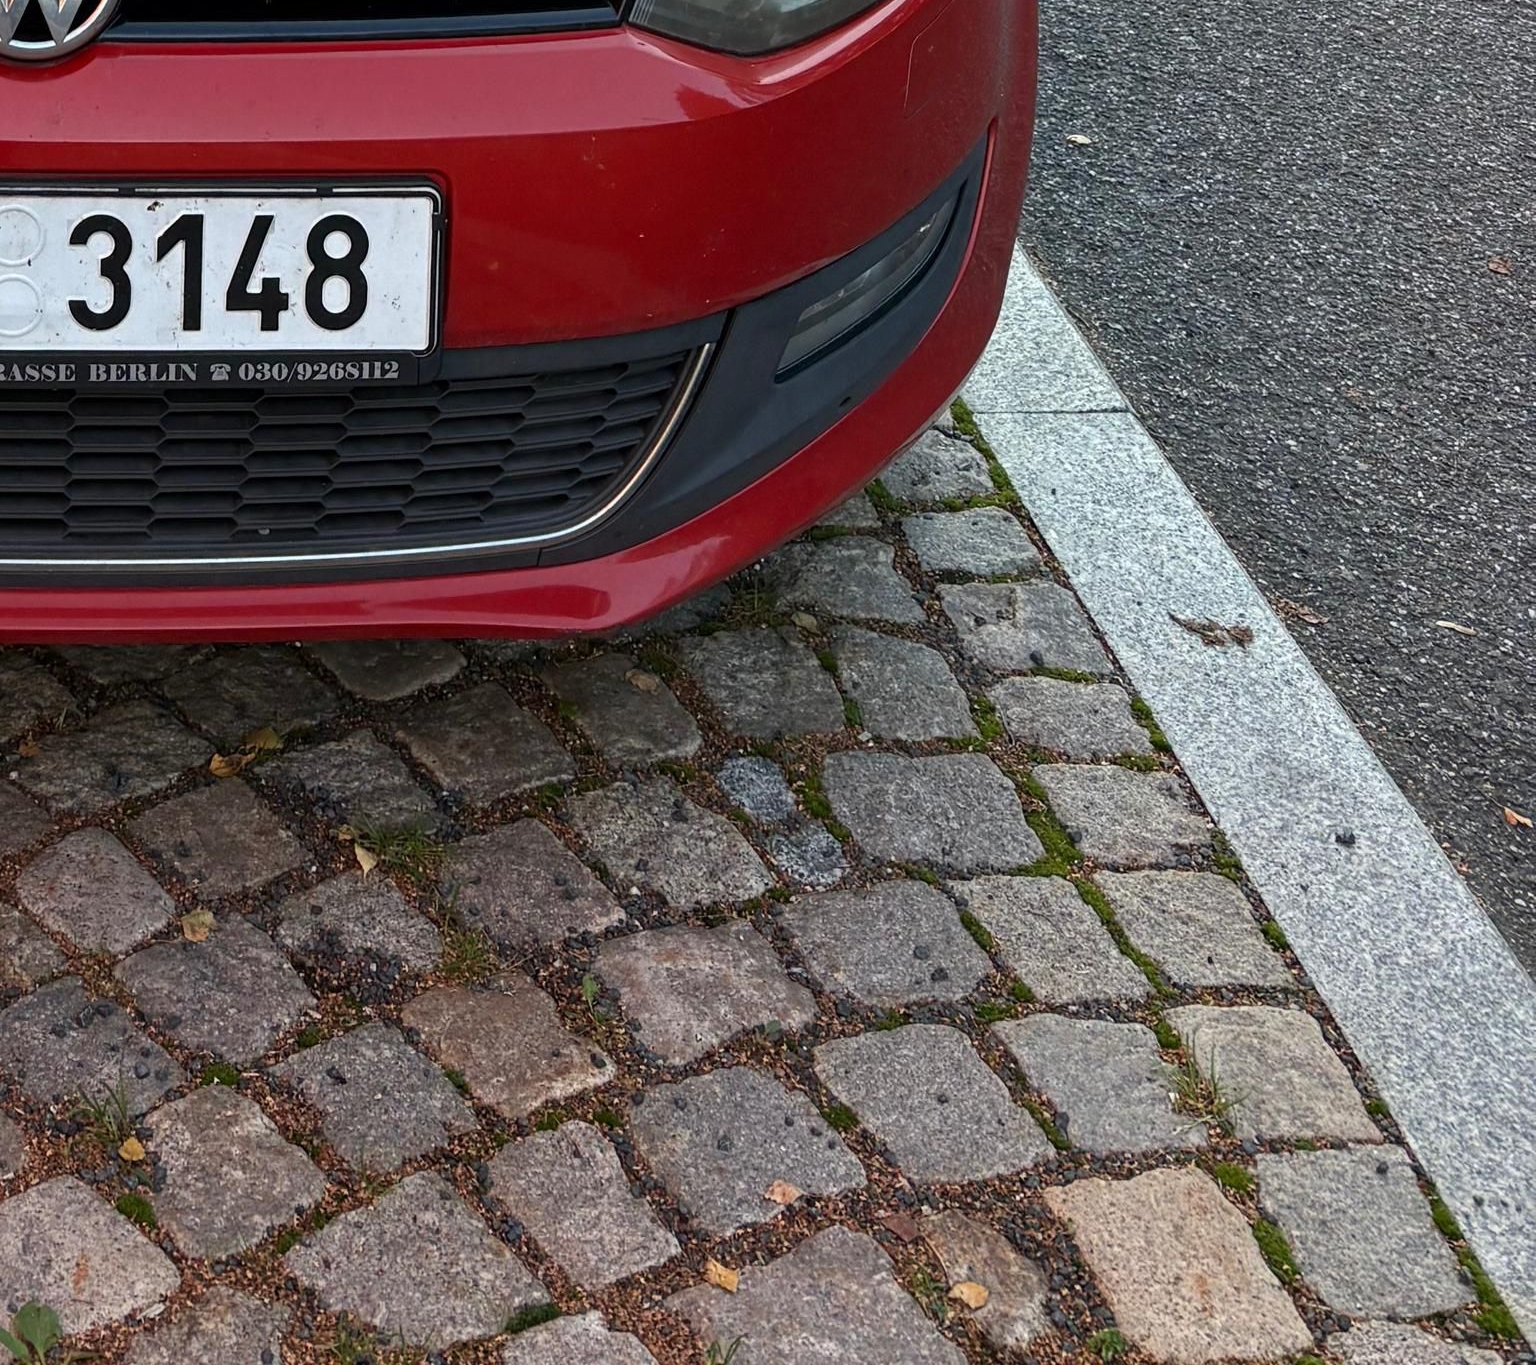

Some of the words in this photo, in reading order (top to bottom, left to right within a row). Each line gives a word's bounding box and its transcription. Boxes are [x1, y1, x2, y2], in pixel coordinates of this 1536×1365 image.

[67, 213, 371, 332] 3148
[88, 362, 198, 383] BERLIN
[238, 359, 400, 383] 030/9268112
